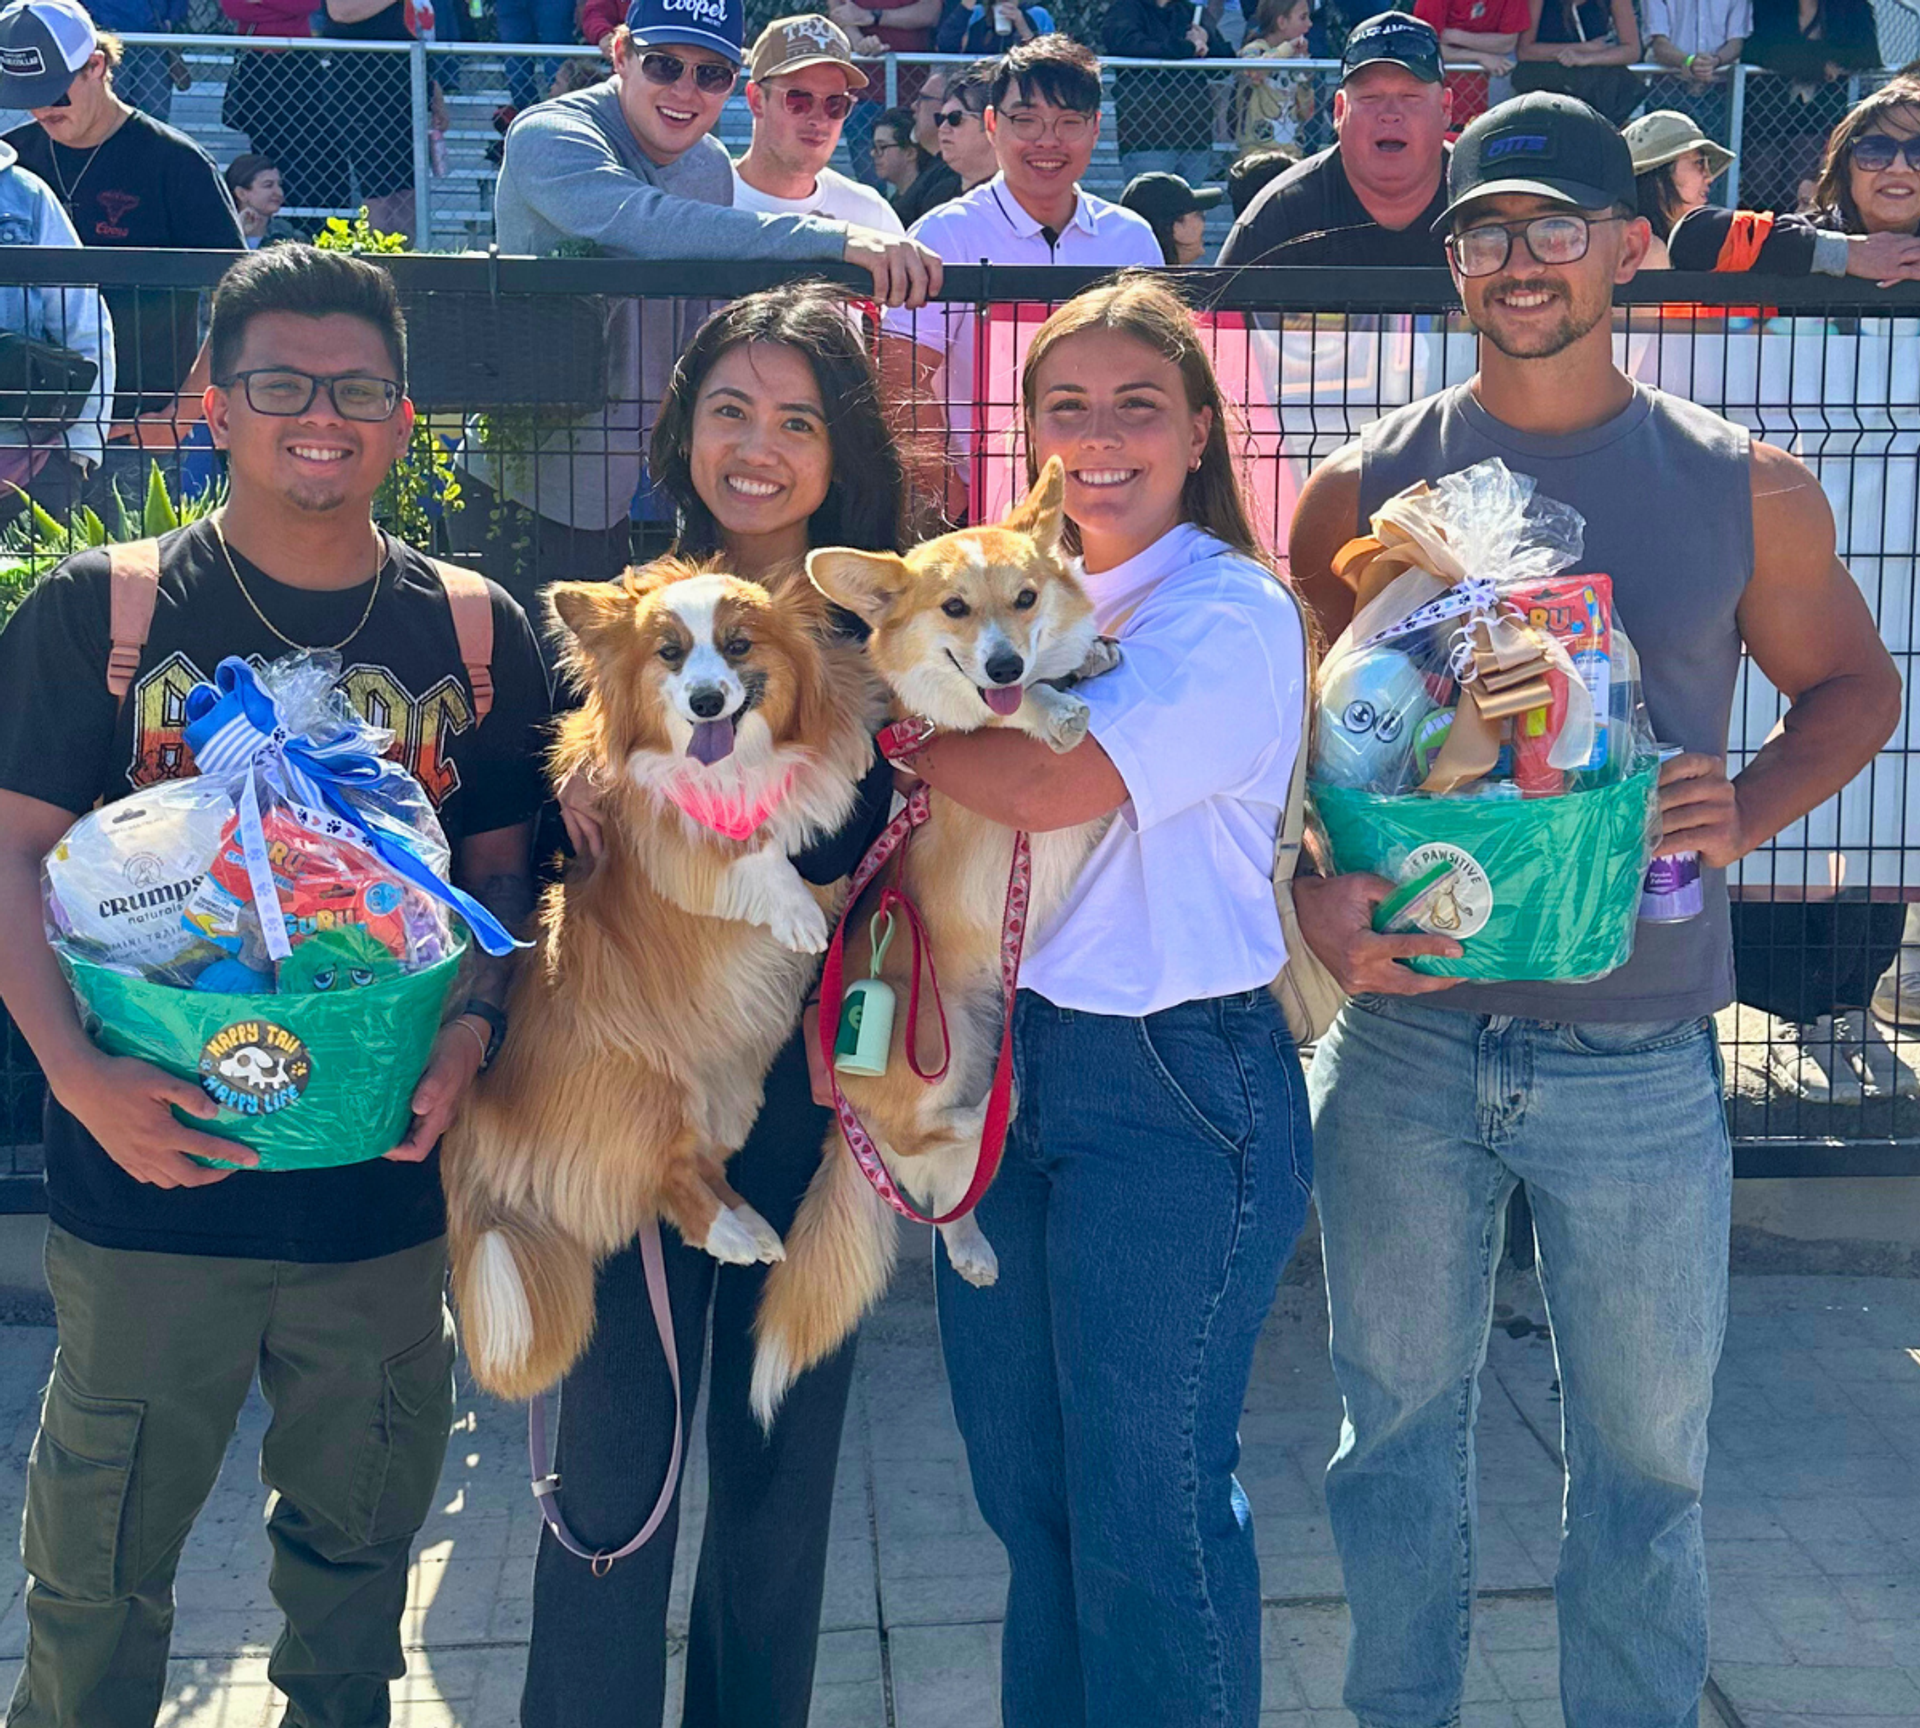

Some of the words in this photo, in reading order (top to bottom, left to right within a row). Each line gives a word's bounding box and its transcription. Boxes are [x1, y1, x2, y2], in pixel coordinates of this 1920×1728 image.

[662, 0, 728, 21] Cooper
[1421, 849, 1482, 885] PAWSITIVE
[128, 902, 183, 925] naturals
[146, 924, 182, 942] TRAI
[206, 1022, 259, 1058] HAPPY
[203, 1074, 259, 1114] HAPPY
[264, 1083, 300, 1113] LIFE
